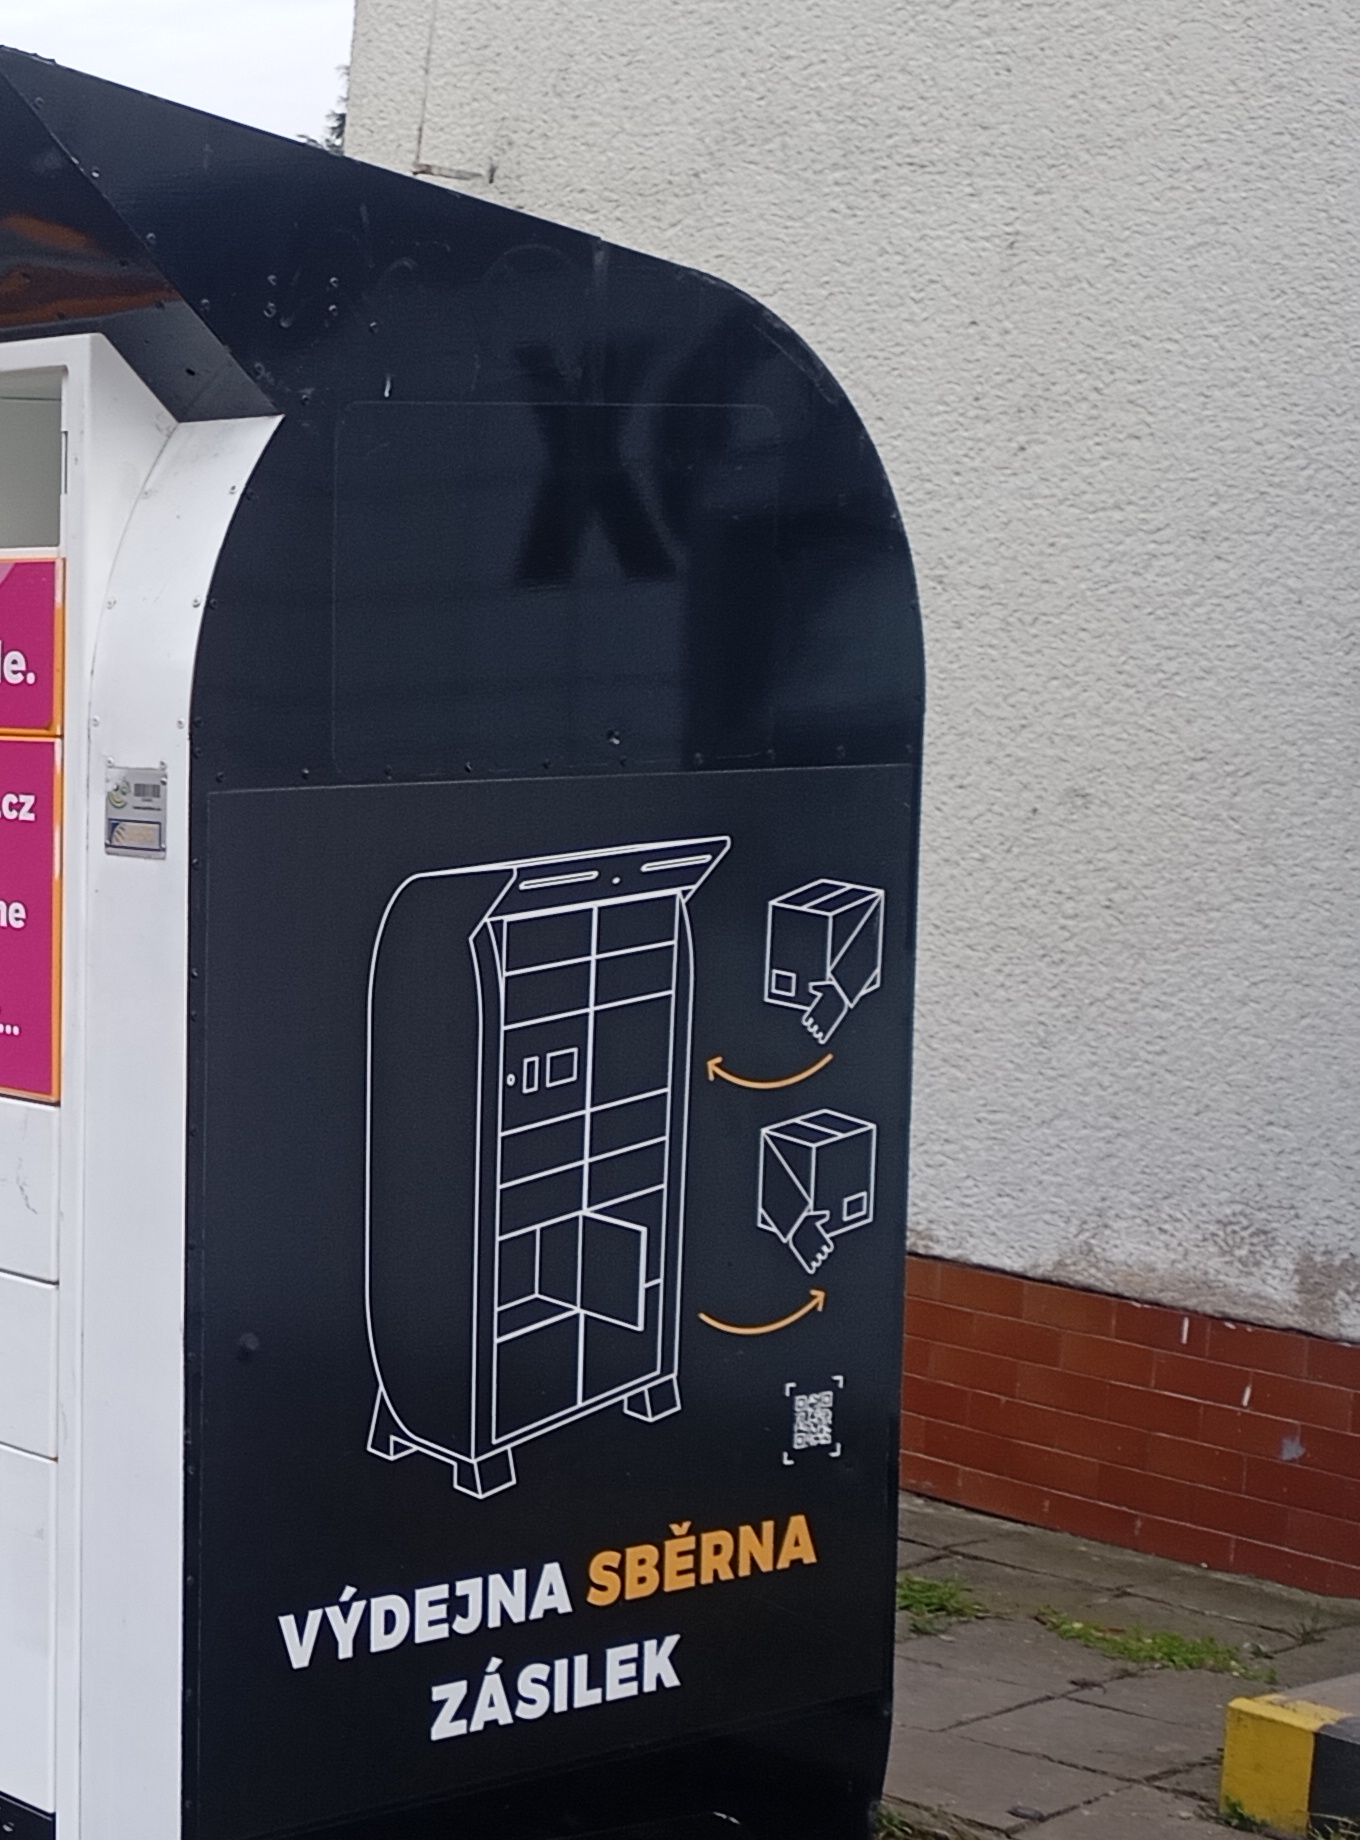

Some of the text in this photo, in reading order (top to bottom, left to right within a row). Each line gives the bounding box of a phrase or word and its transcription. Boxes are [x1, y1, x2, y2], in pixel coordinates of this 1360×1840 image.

[278, 1514, 818, 1670] VÝDEJNA SBĚRNA
[430, 1633, 682, 1741] ZÁSILEK
